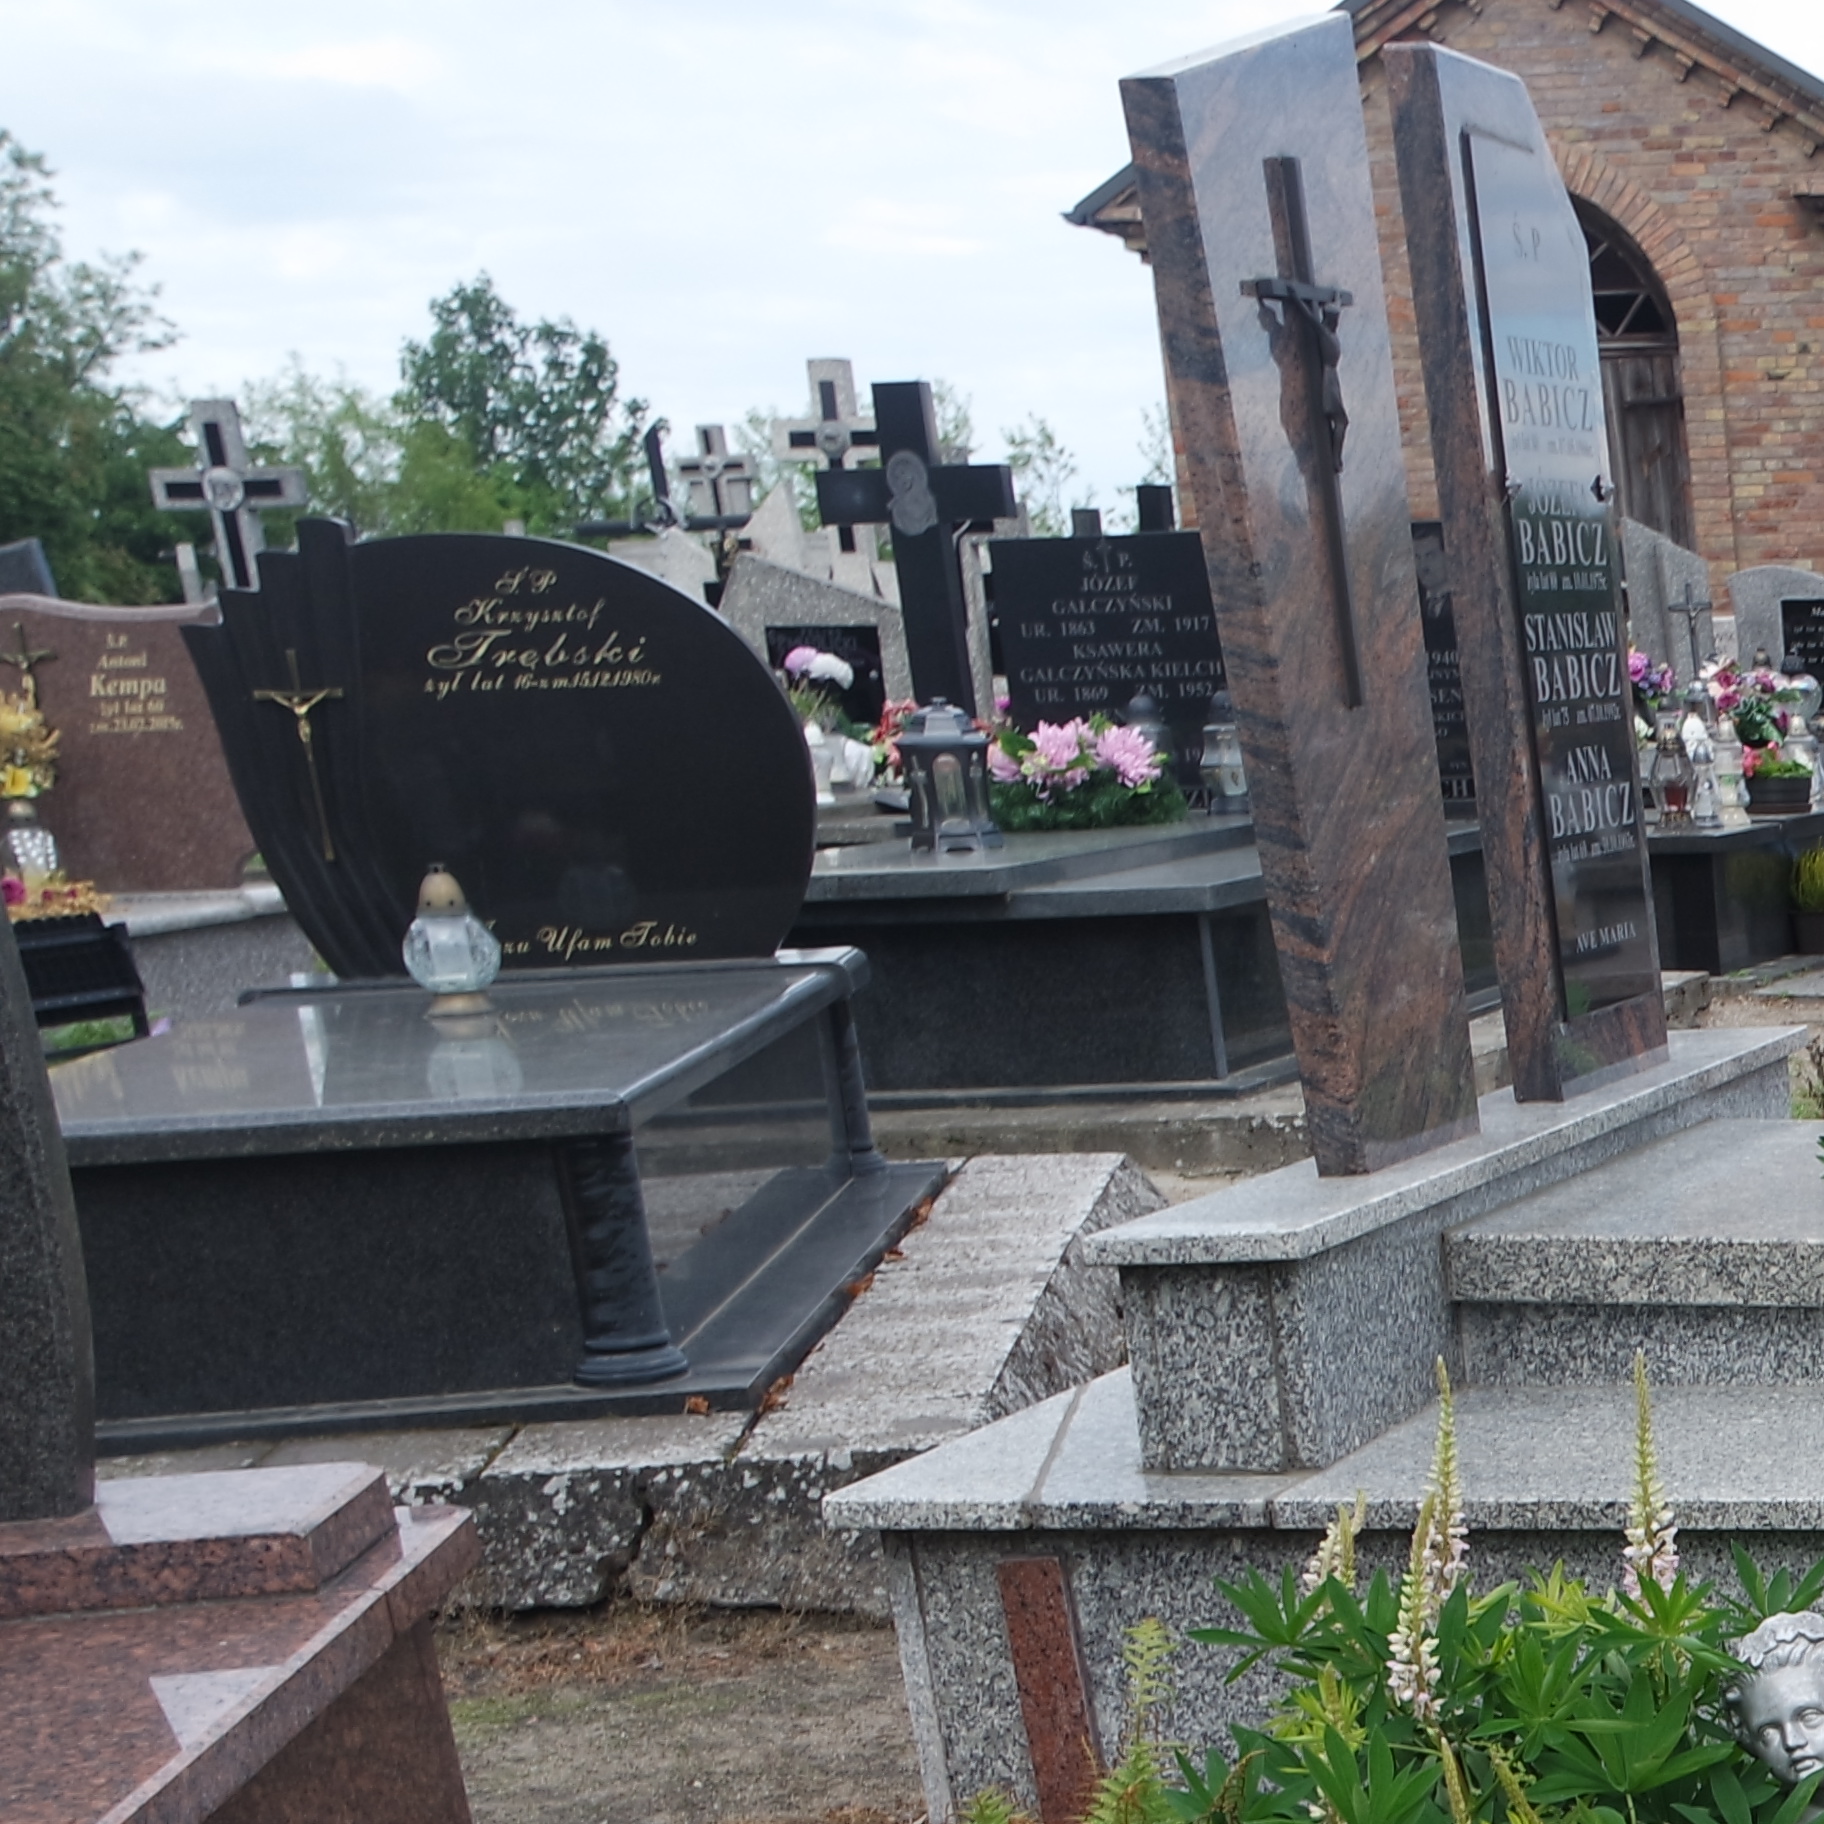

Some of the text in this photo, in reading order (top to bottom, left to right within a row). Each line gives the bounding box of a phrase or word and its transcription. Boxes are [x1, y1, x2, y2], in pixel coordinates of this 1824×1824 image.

[1507, 335, 1579, 381] WIKTOR
[1503, 378, 1593, 432] BABICZ
[1518, 518, 1607, 566] BABICZ
[1080, 574, 1139, 592] JÓZEF
[454, 598, 605, 631] Krzysztof
[1174, 615, 1211, 632] 1917
[1524, 612, 1617, 653] STANISŁAW
[97, 651, 147, 669] Antoni
[427, 629, 647, 670] Trębski
[1072, 641, 1164, 660] KSAWERA
[90, 673, 167, 700] Kempa
[424, 671, 465, 701] żył
[471, 671, 504, 691] lat
[1533, 652, 1621, 703] BABICZ
[1567, 745, 1612, 786] ANNA
[1549, 781, 1635, 839] BABICZ
[537, 926, 613, 961] Ufam
[620, 920, 697, 947] Tobie
[1576, 920, 1637, 954] AVE MARIA
